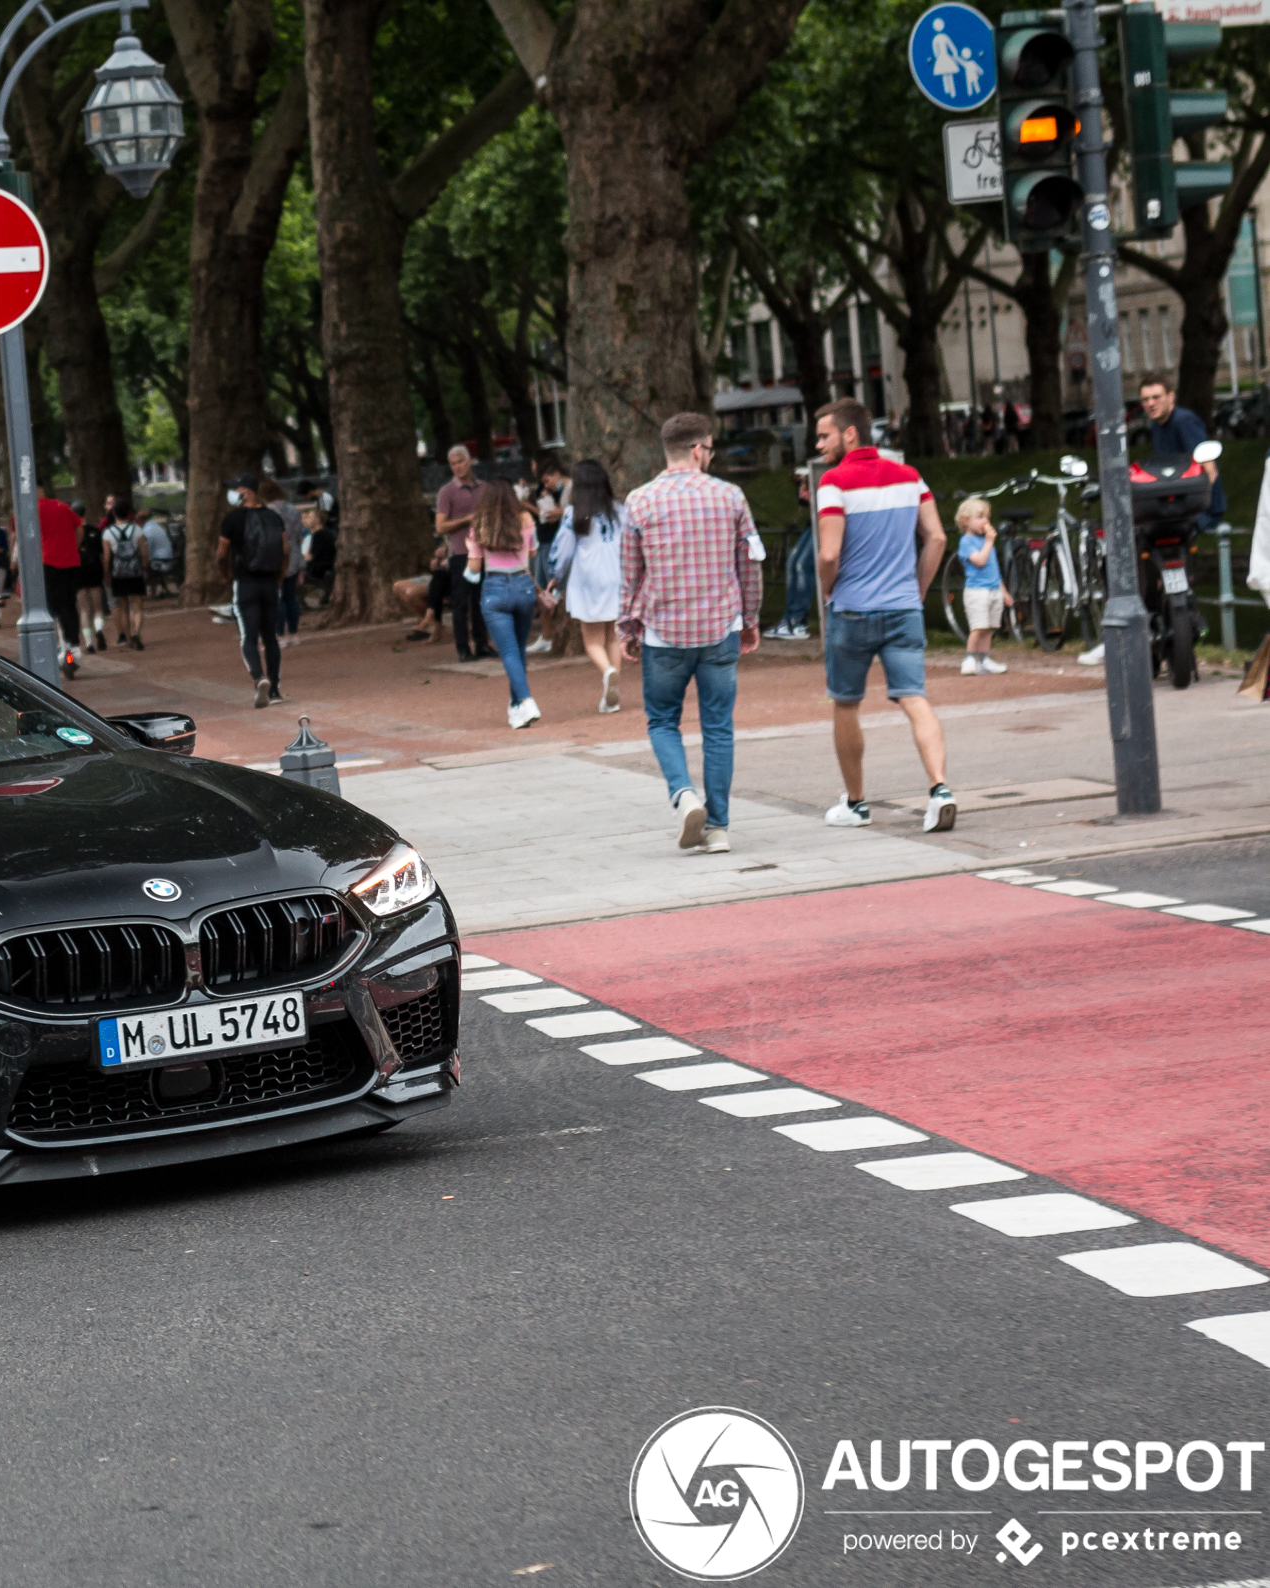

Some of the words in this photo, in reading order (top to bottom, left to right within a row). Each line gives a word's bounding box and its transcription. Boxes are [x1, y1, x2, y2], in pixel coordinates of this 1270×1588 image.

[122, 1020, 146, 1058] M
[167, 1012, 213, 1050] UL
[219, 997, 300, 1042] 5748
[106, 1047, 115, 1058] D
